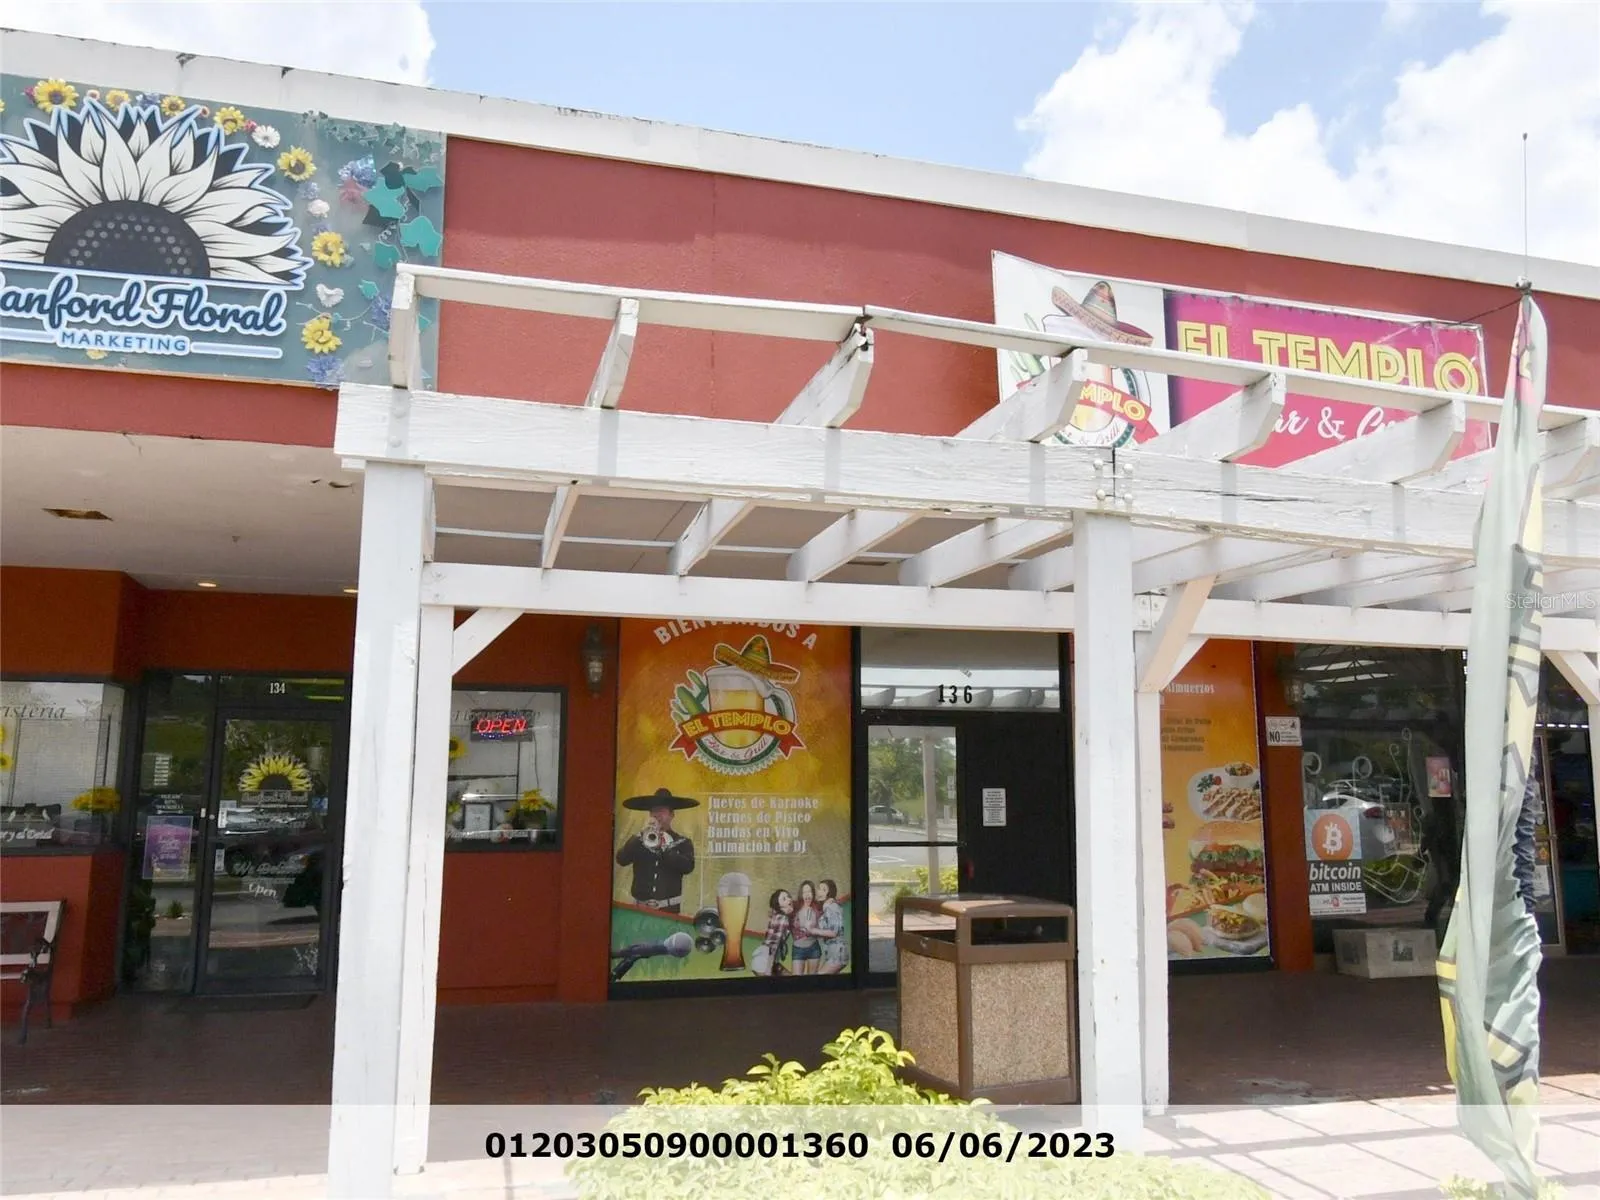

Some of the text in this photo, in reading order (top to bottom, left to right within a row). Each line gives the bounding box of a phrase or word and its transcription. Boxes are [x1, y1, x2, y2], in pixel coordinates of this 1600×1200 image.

[0, 275, 284, 333] anford Floral
[61, 331, 188, 352] MARKETING
[1078, 383, 1147, 421] MPLO
[1317, 406, 1346, 441] &
[802, 632, 818, 650] A
[270, 682, 285, 694] 134
[937, 684, 973, 704] 136
[476, 718, 528, 734] OPEN
[682, 711, 792, 738] EL TEMPLO
[1269, 730, 1281, 743] NO
[708, 796, 819, 809] Jueves de Karaoke
[708, 811, 752, 823] Viernes
[757, 811, 771, 823] de
[708, 826, 800, 838] Bandas en Vivo
[775, 840, 789, 852] de
[793, 839, 808, 853] DJ
[1309, 862, 1361, 881] bitcoin
[1310, 881, 1362, 893] ATM INSIDE
